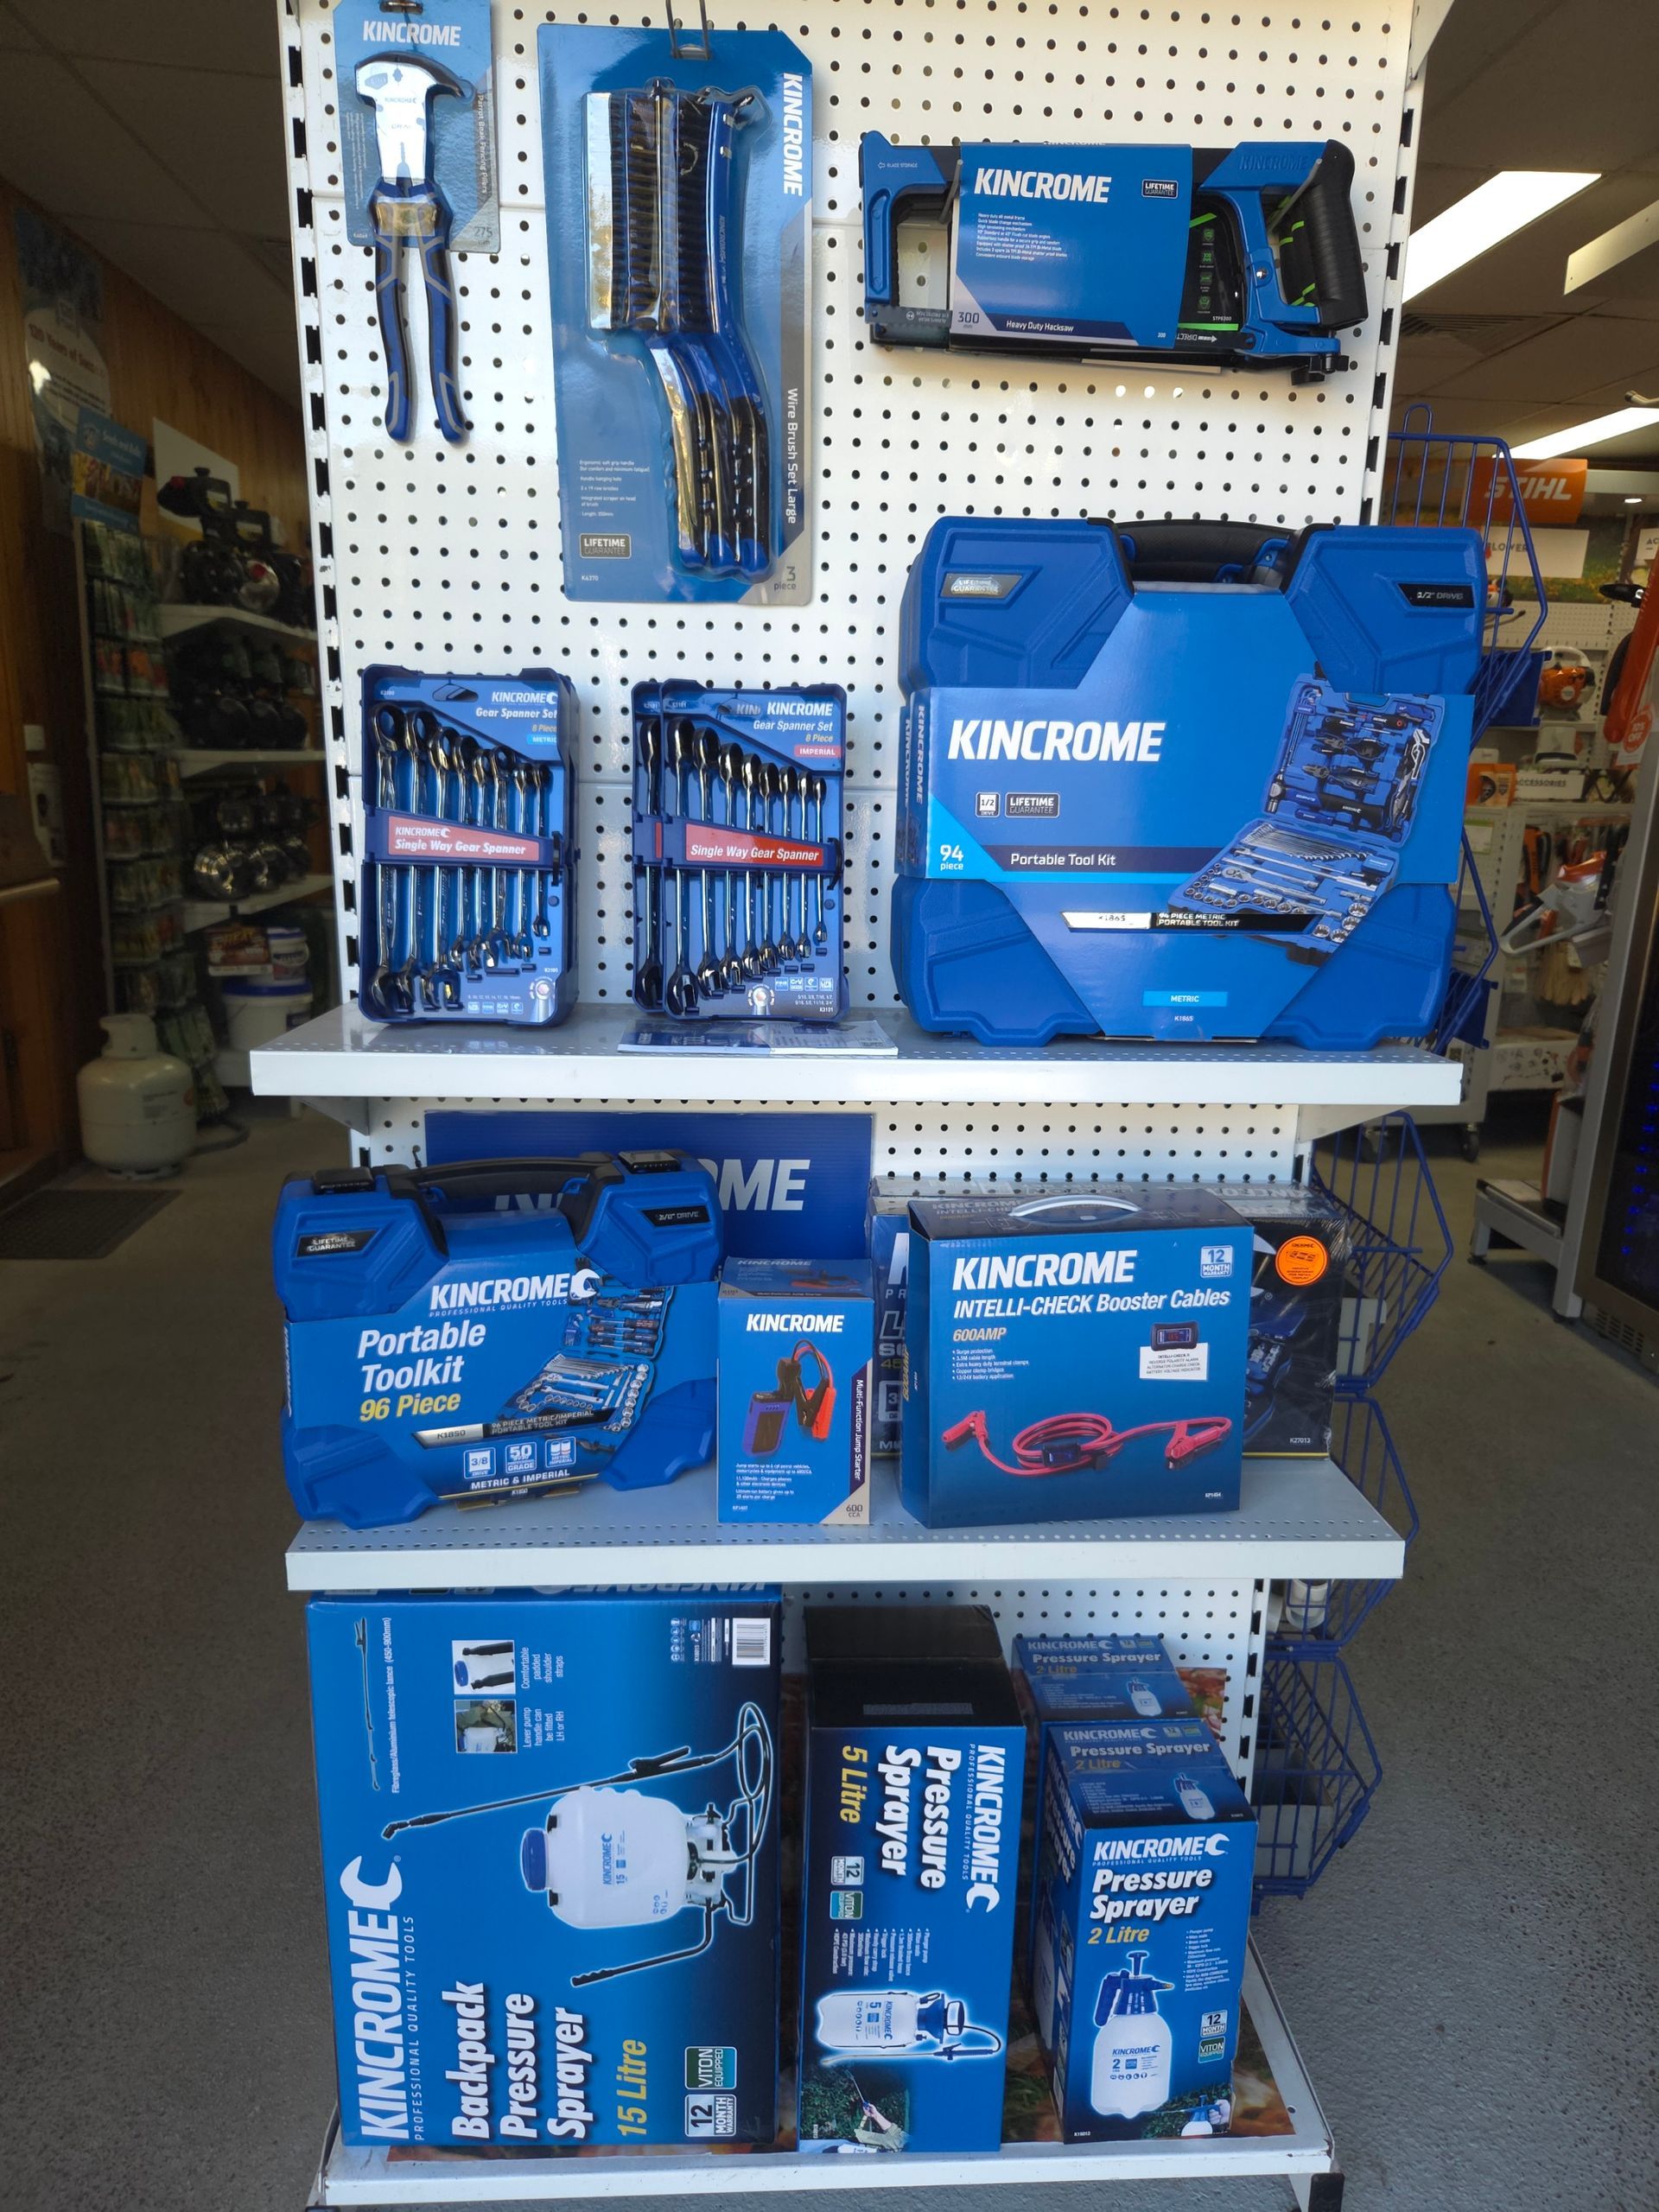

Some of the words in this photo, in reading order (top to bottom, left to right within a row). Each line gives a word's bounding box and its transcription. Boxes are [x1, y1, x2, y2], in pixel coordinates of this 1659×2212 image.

[363, 20, 461, 47] KINCROME
[784, 73, 803, 197] KINCROME
[974, 168, 1113, 203] KINCROME
[474, 226, 493, 238] 275
[957, 311, 980, 324] 300
[1006, 320, 1027, 331] Heavy
[1027, 321, 1044, 332] Duty
[1045, 322, 1074, 333] Hacksaw
[787, 388, 798, 419] Wire
[787, 423, 798, 460] Brush
[787, 463, 798, 485] Set
[1484, 476, 1573, 500] STIHL
[785, 488, 798, 524] Large
[583, 538, 626, 547] LIFETIME
[786, 566, 796, 582] 3
[773, 582, 797, 592] piece
[491, 691, 546, 704] KINCROME
[475, 707, 498, 717] Gear
[500, 708, 540, 719] Spanner
[766, 702, 834, 716] KINCROME
[753, 721, 776, 730] Gear
[777, 721, 815, 733] Spanner
[817, 721, 834, 732] Set
[812, 734, 834, 742] Piece
[948, 719, 1166, 762] KINCROME
[799, 747, 836, 756] IMPERIAL
[916, 704, 926, 805] KINCROME
[1009, 797, 1055, 806] LIFETIME
[1009, 805, 1054, 815] GUARANTEE
[395, 827, 442, 838] KINCROME
[394, 839, 428, 852] Single
[429, 841, 453, 853] Way
[454, 842, 481, 853] Gear
[482, 842, 526, 855] Spanner
[690, 844, 724, 858] Single
[726, 846, 748, 860] Way
[751, 847, 775, 859] Gear
[776, 849, 819, 861] Spanner
[939, 843, 964, 862] 94
[940, 861, 964, 871] piece
[1010, 853, 1065, 866] Portable
[1068, 854, 1095, 866] Tool
[1097, 854, 1116, 866] Kit
[1170, 995, 1199, 1003] METRIC
[1207, 1249, 1225, 1263] 12
[952, 1249, 1138, 1291] KINCROME
[1202, 1263, 1230, 1272] MONTH
[429, 1274, 571, 1310] KINCROME
[429, 1306, 497, 1319] PROFESSIONAL
[499, 1302, 537, 1313] QUALITY
[540, 1298, 568, 1307] TOOLS
[953, 1294, 1094, 1319] INTELLI-CHECK
[1096, 1293, 1166, 1313] Booster
[1169, 1287, 1231, 1309] Cables
[746, 1313, 845, 1332] KINCROME
[357, 1319, 486, 1359] Portable
[953, 1326, 1007, 1342] 600AMP
[361, 1355, 465, 1393] Toolkit
[359, 1397, 391, 1422] 96
[396, 1392, 461, 1418] Piece
[855, 1379, 864, 1433] Multi-Function
[502, 1419, 526, 1427] PIECE
[526, 1410, 594, 1424] METRIC/IMPERIAL
[436, 1429, 466, 1440] K1850
[491, 1425, 532, 1435] PORTABLE
[509, 1444, 533, 1457] 50
[854, 1433, 862, 1454] Jump
[471, 1457, 489, 1466] 3/8
[507, 1462, 535, 1471] GRADE
[854, 1454, 862, 1480] Starter
[470, 1478, 510, 1491] METRIC
[523, 1469, 570, 1483] IMPERIAL
[846, 1503, 863, 1513] 600
[1027, 1640, 1098, 1650] KINCROME
[520, 1647, 530, 1689] Comfortable
[532, 1654, 542, 1680] padded
[543, 1653, 552, 1683] shoulder
[556, 1656, 564, 1678] straps
[1033, 1653, 1098, 1663] Pressure
[1102, 1652, 1160, 1664] Sprayer
[385, 1666, 395, 1686] lance
[386, 1688, 397, 1720] telescopic
[523, 1728, 531, 1748] Lever
[1064, 1728, 1141, 1741] KINCROME
[842, 1745, 868, 1763] 5
[1070, 1745, 1142, 1757] Pressure
[1146, 1743, 1211, 1756] Sprayer
[1088, 1758, 1121, 1770] Litre
[966, 1744, 976, 1814] PROFESSIONAL
[840, 1767, 868, 1824] Litre
[875, 1745, 922, 1877] Sprayer
[920, 1745, 962, 1889] Pressure
[970, 1745, 1006, 1884] KINCROME
[1093, 1836, 1205, 1861] KINCROME
[846, 1862, 861, 1878] 12
[1092, 1859, 1145, 1867] PROFESSIONAL
[1092, 1868, 1212, 1893] Pressure
[844, 1892, 855, 1918] VITON
[1090, 1894, 1199, 1923] Sprayer
[403, 1915, 416, 1962] TOOLS
[1087, 1927, 1103, 1944] 2
[1105, 1926, 1150, 1944] Litre
[404, 1970, 419, 2032] QUALITY
[347, 1909, 410, 2139] KINCROME
[1206, 2013, 1221, 2025] 12
[1112, 2045, 1152, 2056] KINCROME
[1200, 2042, 1224, 2053] VITON
[442, 1980, 495, 2139] Backpack
[499, 1993, 538, 2139] Pressure
[616, 2038, 646, 2101] Litre
[697, 2047, 713, 2088] VITON
[714, 2047, 723, 2088] EQUIPPED
[1112, 2058, 1121, 2069] 2
[547, 2006, 594, 2139] Sprayer
[409, 2038, 425, 2141] PROFESSIONAL
[617, 2104, 647, 2137] 15
[690, 2104, 712, 2128] 12
[715, 2097, 726, 2135] MONTH
